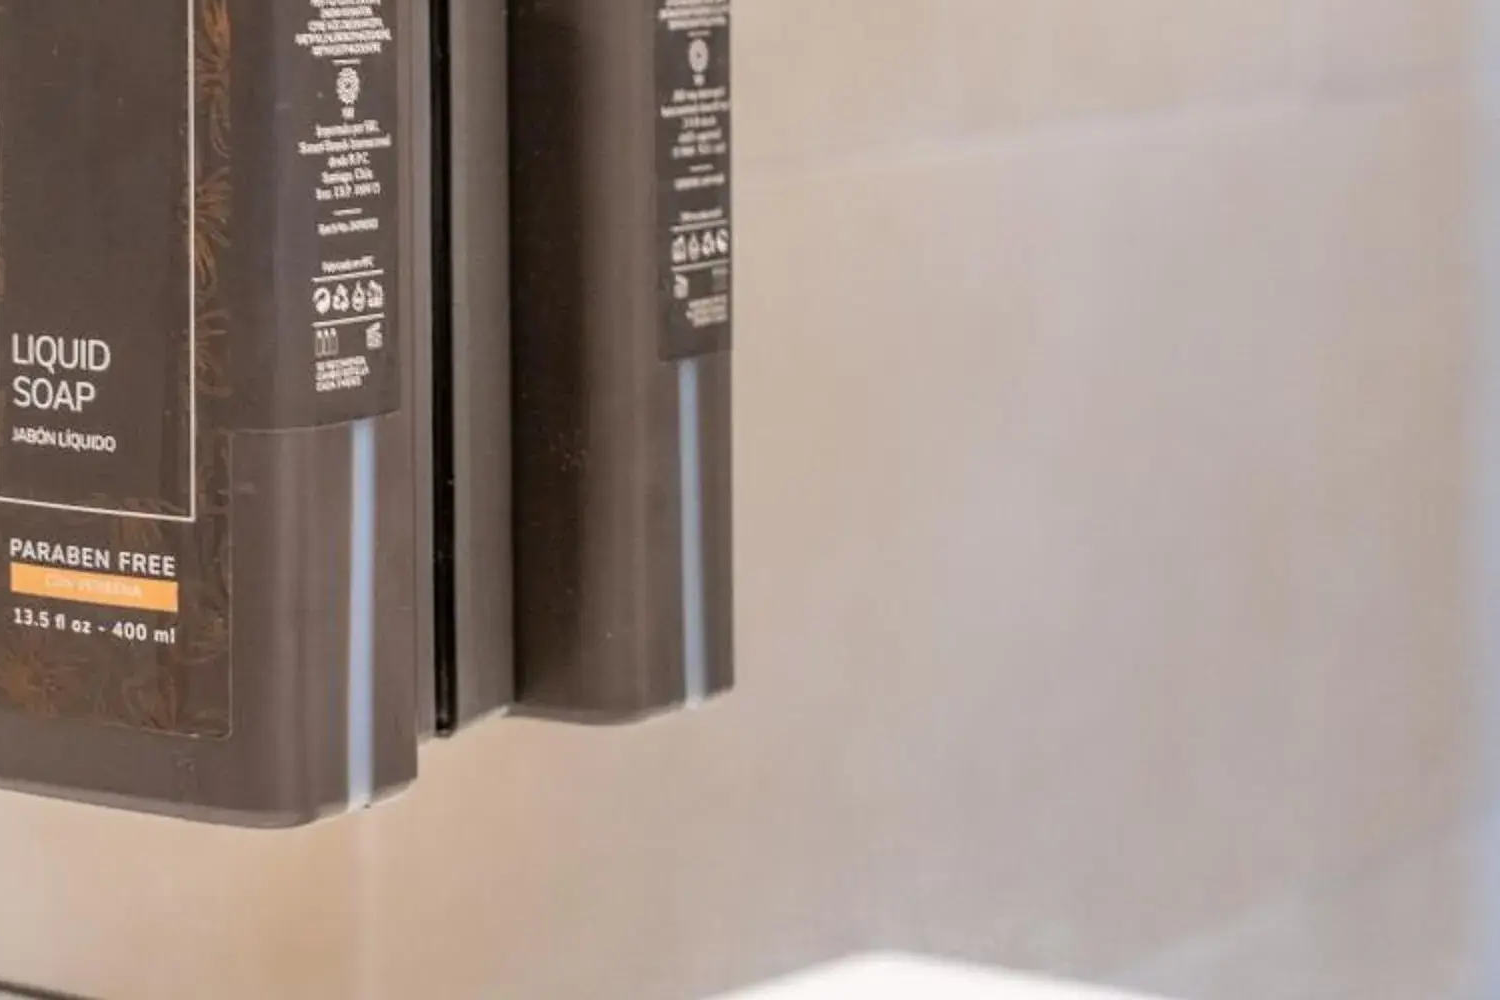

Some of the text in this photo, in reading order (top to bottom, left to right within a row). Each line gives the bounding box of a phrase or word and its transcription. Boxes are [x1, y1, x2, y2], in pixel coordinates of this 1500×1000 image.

[11, 332, 112, 375] LIQUID
[12, 375, 97, 412] SOAP
[11, 425, 117, 454] JABÓN LÍQUIDO
[9, 537, 176, 577] PARABEN FREE
[13, 607, 50, 629] 13.5
[54, 613, 66, 631] fl
[71, 619, 92, 635] oz
[111, 620, 148, 642] 400
[153, 626, 176, 645] ml
